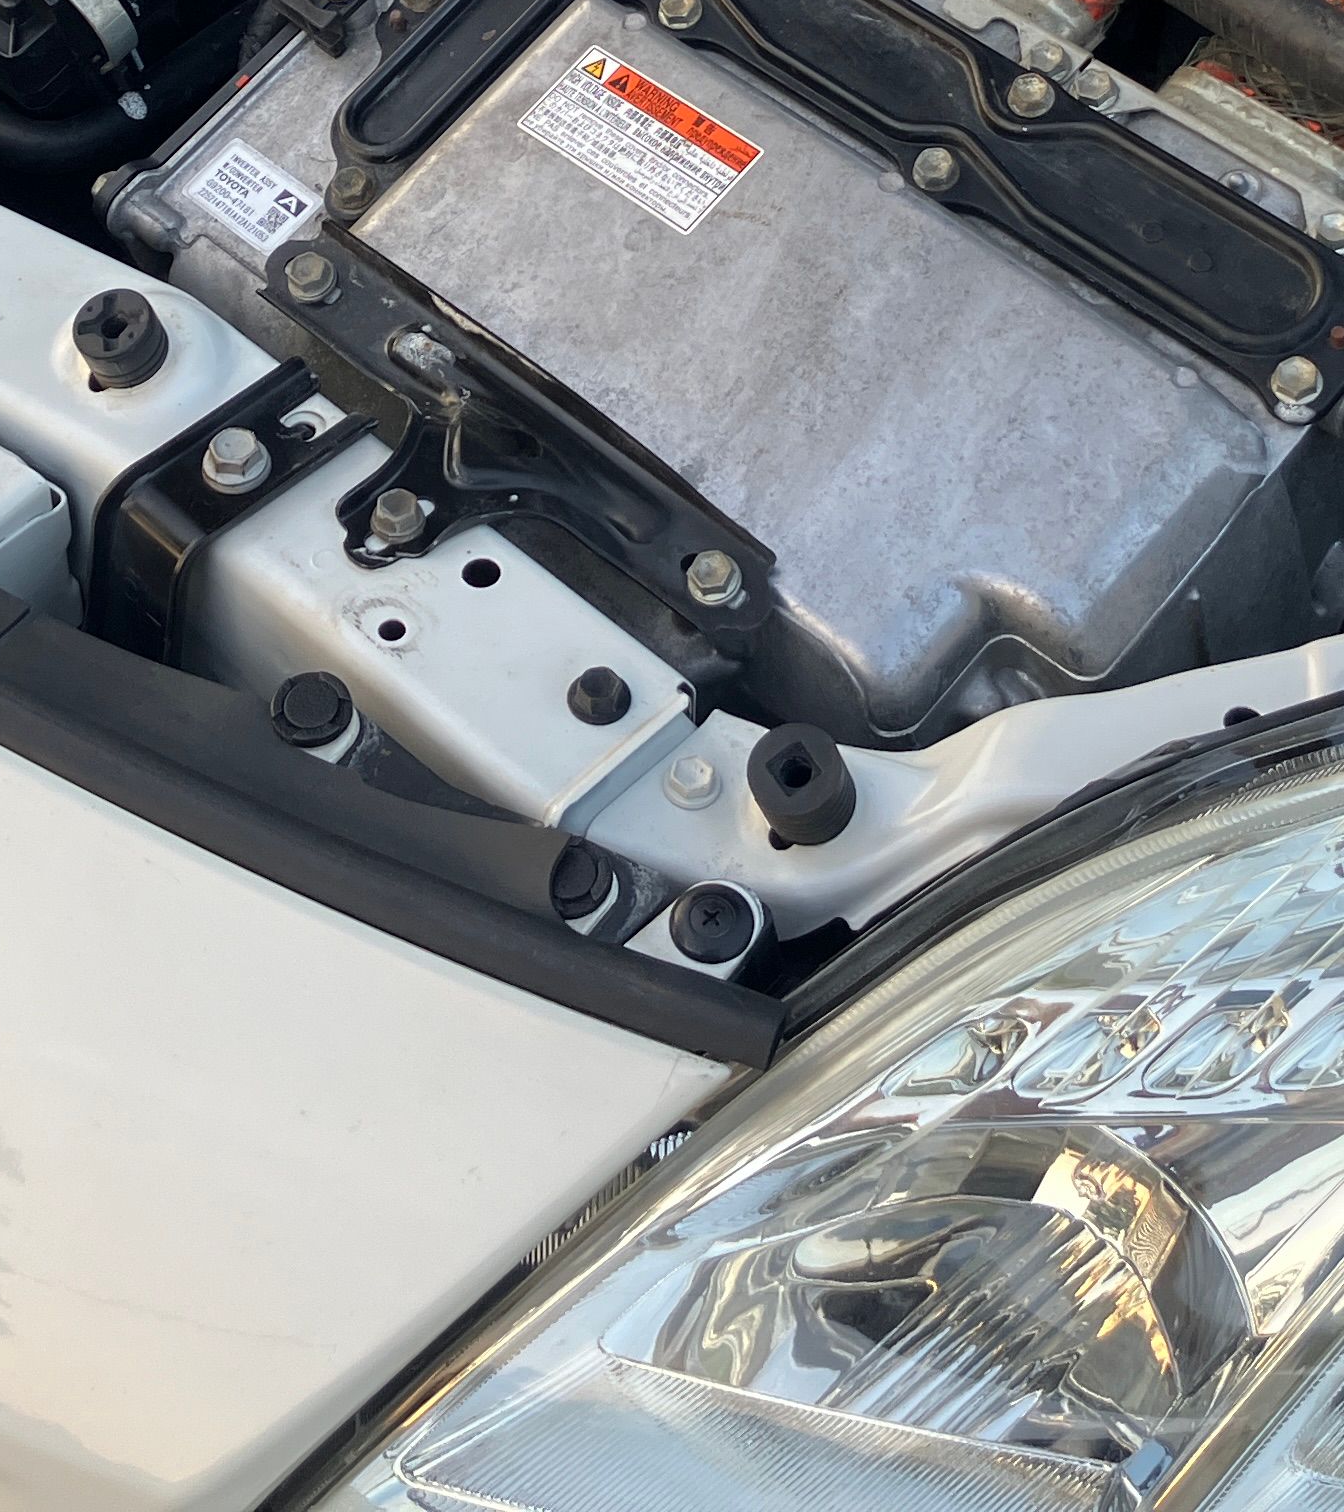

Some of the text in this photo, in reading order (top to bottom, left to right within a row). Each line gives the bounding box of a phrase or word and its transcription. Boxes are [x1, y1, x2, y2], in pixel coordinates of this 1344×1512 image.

[556, 81, 577, 97] HAUTE
[573, 92, 598, 110] TENSION
[565, 71, 584, 85] HIGH
[579, 79, 607, 100] VOLTAGE
[601, 93, 624, 111] INSIDE
[623, 88, 683, 129] AVERTISSEMENT
[632, 79, 681, 113] WARNING
[542, 119, 560, 132] PAS
[548, 91, 562, 102] DO
[561, 100, 579, 113] NOT
[578, 111, 604, 130] remove
[604, 127, 625, 143] these
[212, 168, 251, 198] TOYOTA
[228, 153, 278, 190] INVERTER ASSY
